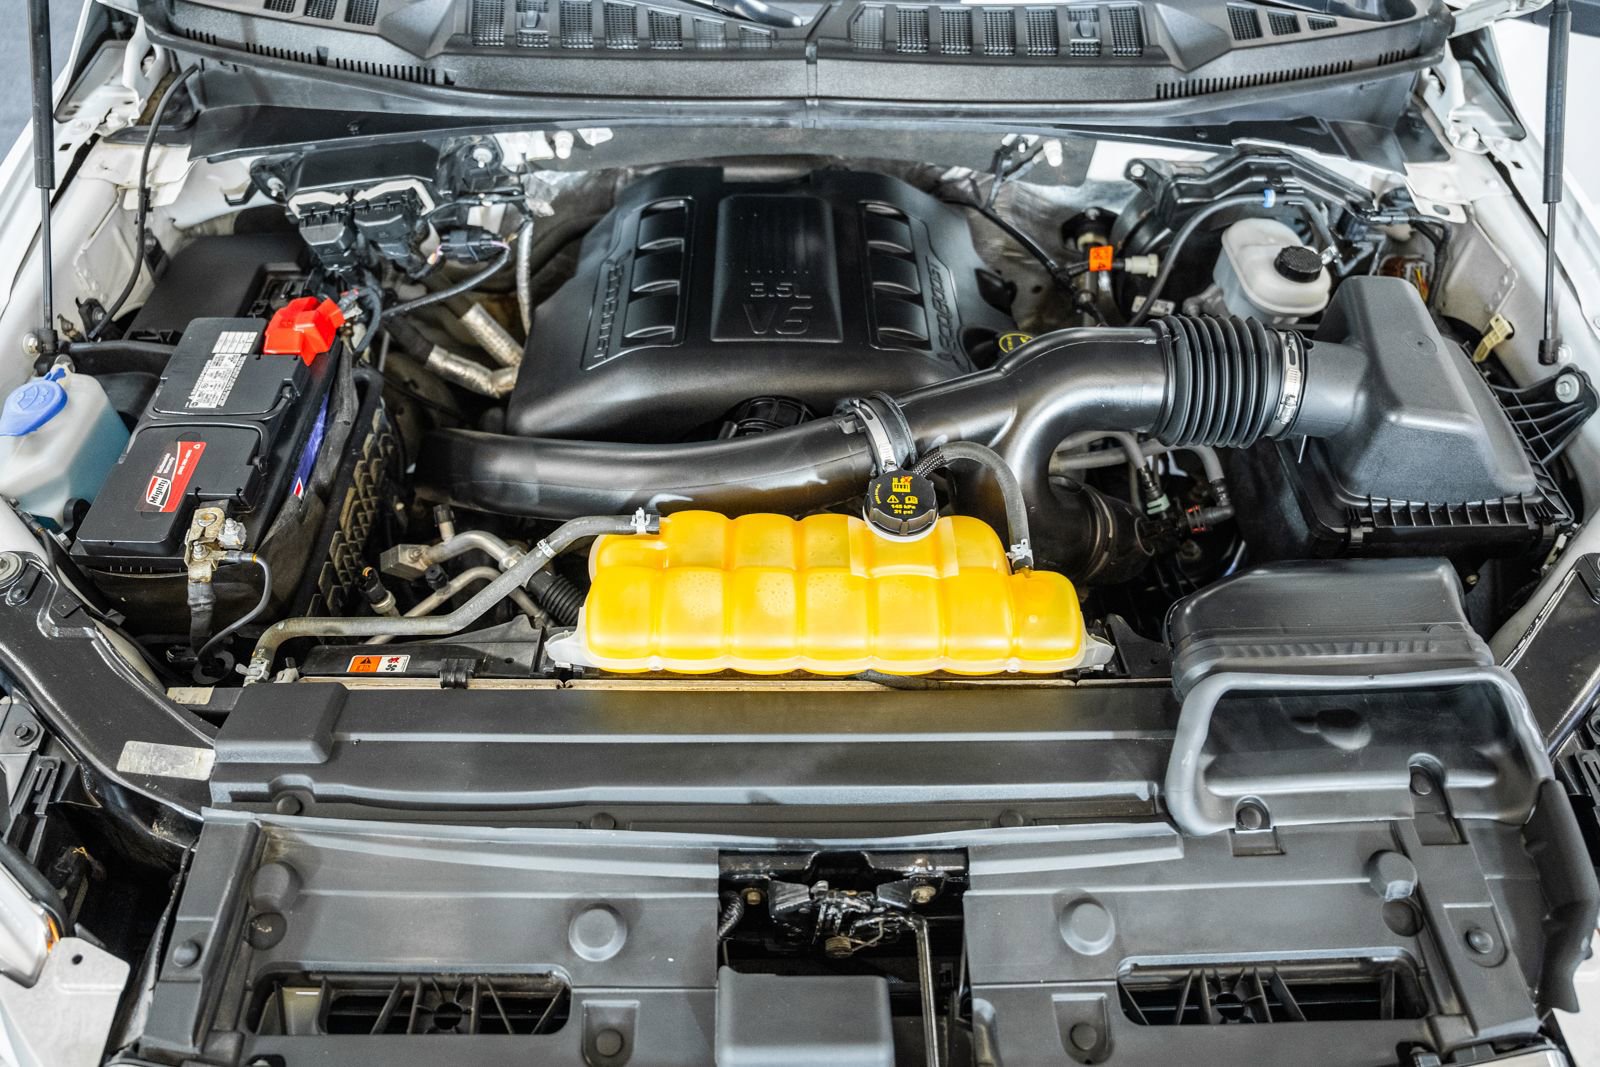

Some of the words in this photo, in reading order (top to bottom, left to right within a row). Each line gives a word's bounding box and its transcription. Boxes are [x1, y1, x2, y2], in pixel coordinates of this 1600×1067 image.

[750, 282, 812, 299] 3.5L
[742, 303, 814, 335] V6
[149, 480, 168, 503] Mighty
